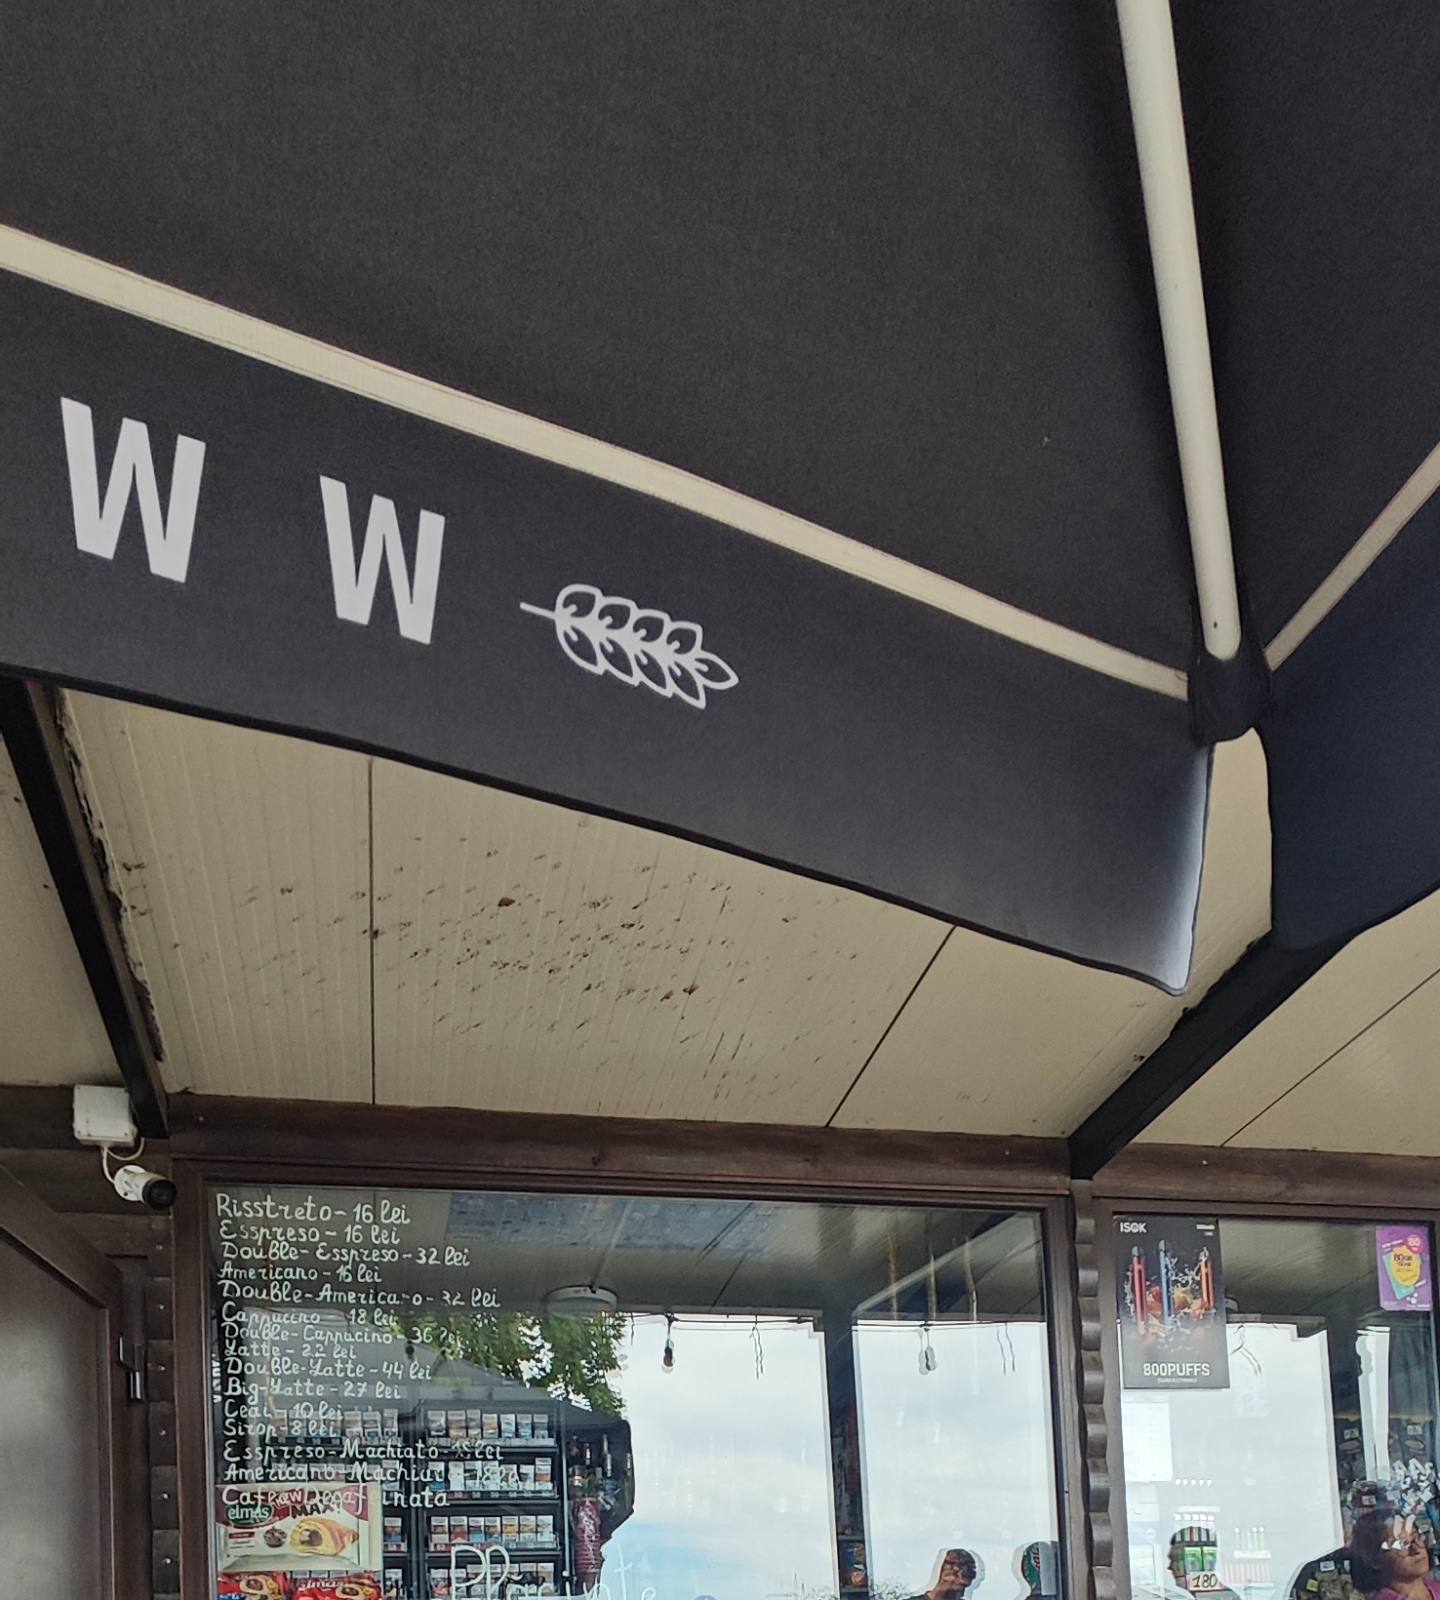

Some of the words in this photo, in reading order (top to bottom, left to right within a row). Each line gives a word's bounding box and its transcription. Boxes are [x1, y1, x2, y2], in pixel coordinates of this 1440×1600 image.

[61, 397, 206, 583] W
[320, 475, 446, 645] W
[381, 1200, 411, 1224] lei
[371, 1225, 401, 1245] lei
[416, 1247, 441, 1265] 32
[444, 1246, 471, 1267] lei
[217, 1260, 318, 1281] Americano
[357, 1263, 383, 1283] lei
[471, 1287, 502, 1308] lei
[374, 1308, 398, 1327] lei
[302, 1344, 327, 1358] 22
[333, 1344, 357, 1359] lei
[382, 1361, 404, 1379] 44
[410, 1361, 432, 1380] lei
[1143, 1362, 1210, 1377] 800PUFFS
[344, 1381, 368, 1398] 27
[375, 1381, 402, 1399] lei
[1192, 1573, 1218, 1588] 180
